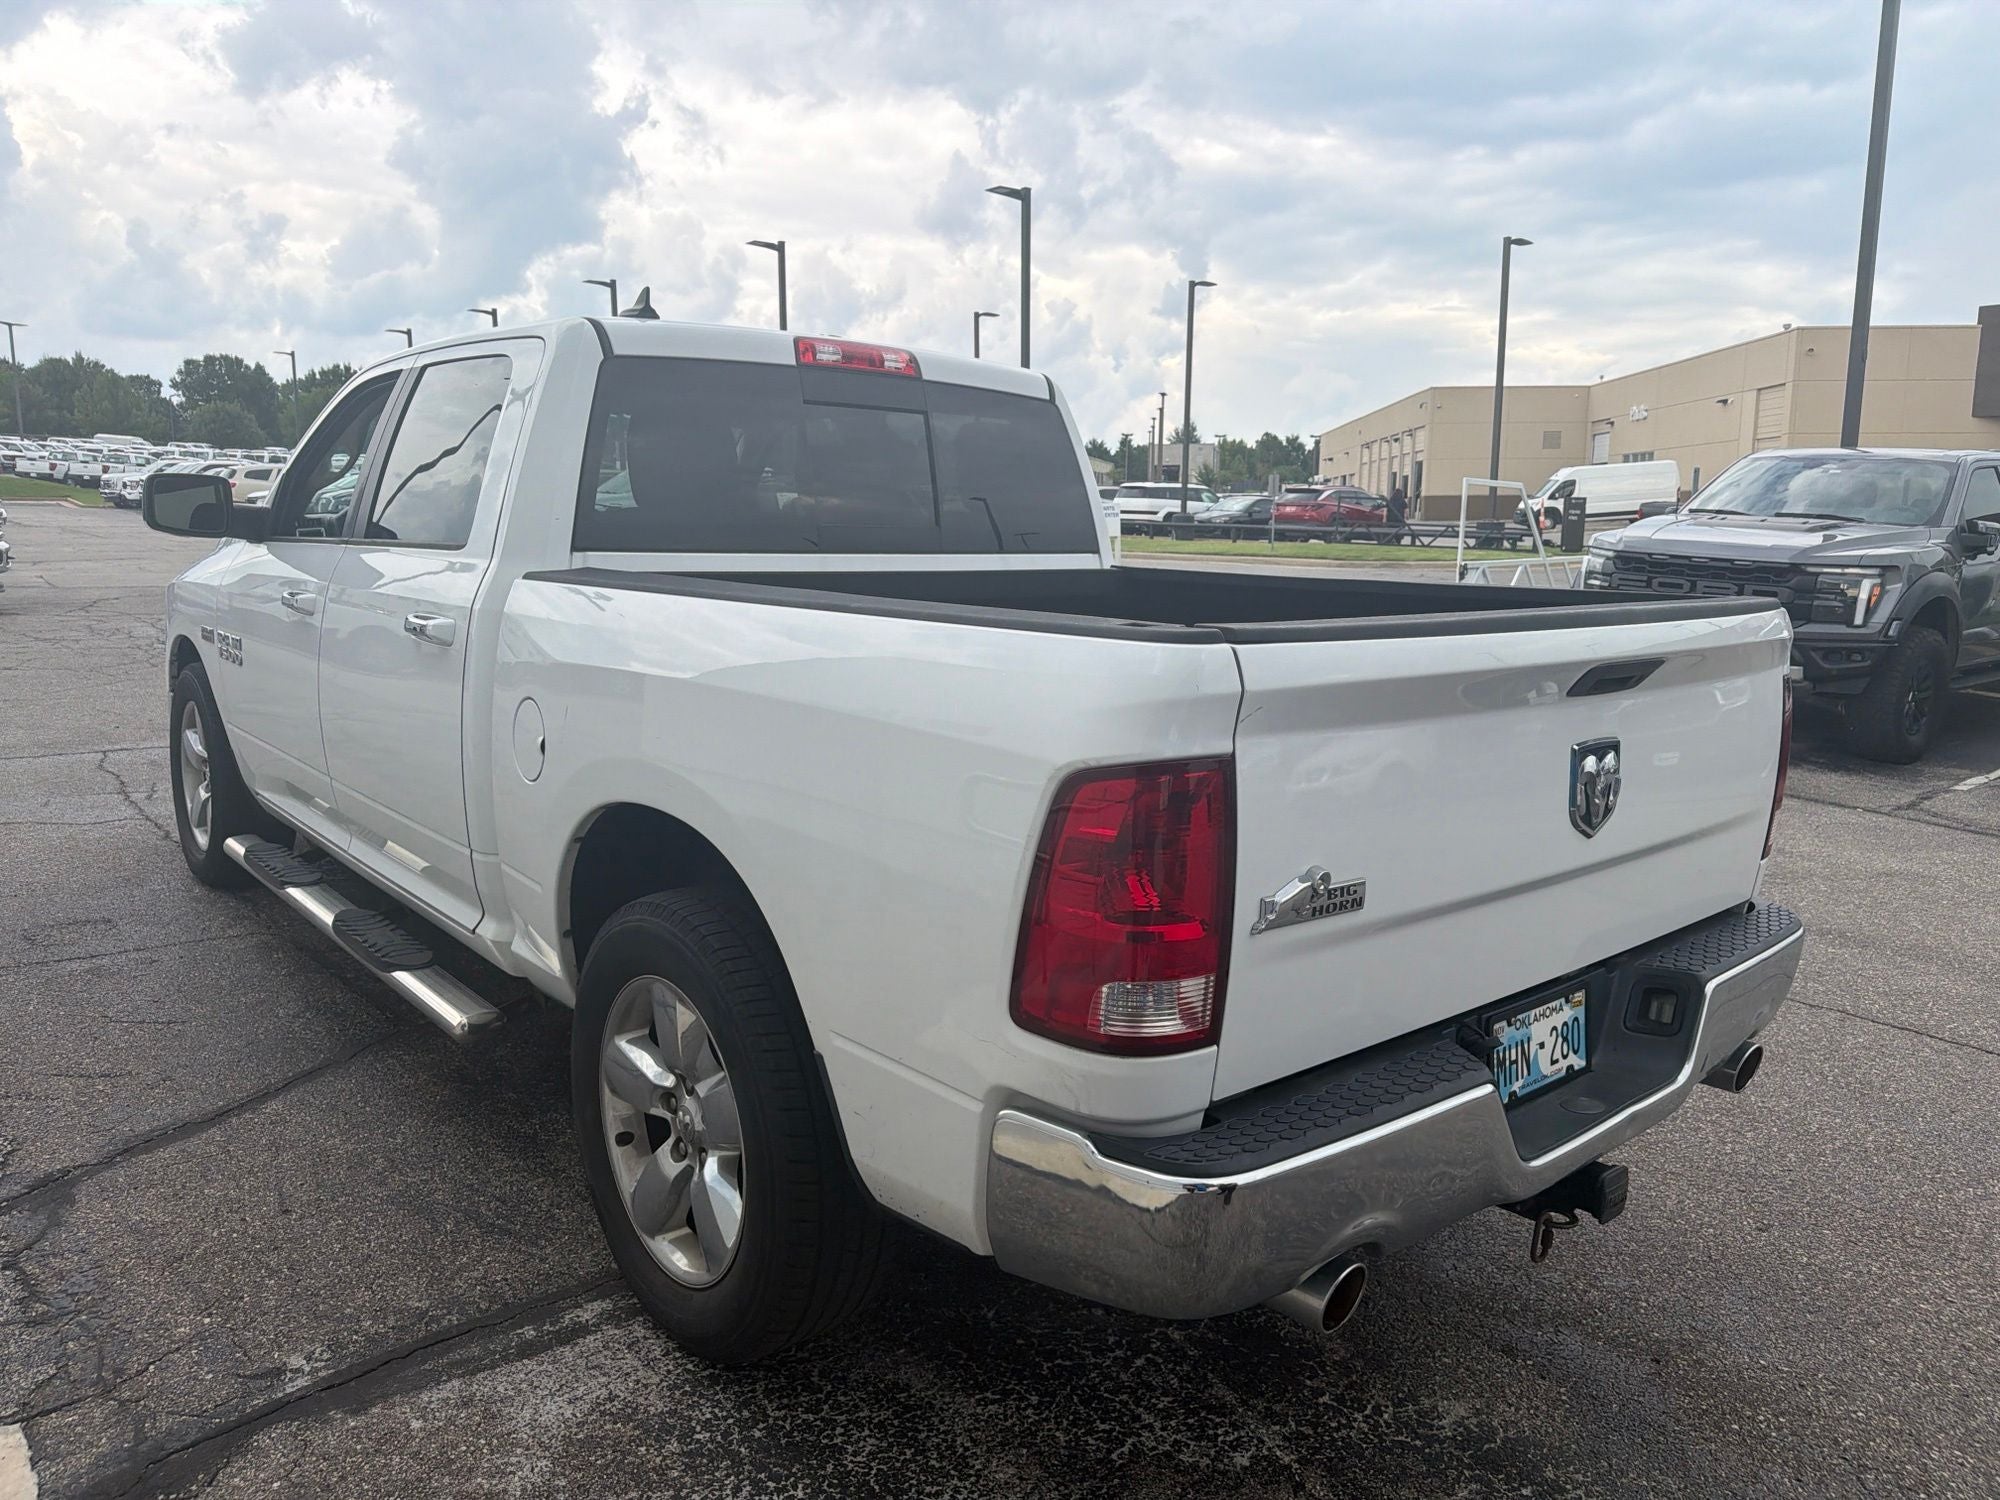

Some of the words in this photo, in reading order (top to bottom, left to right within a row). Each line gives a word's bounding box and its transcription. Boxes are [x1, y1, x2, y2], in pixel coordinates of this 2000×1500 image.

[1611, 573, 1795, 604] FORD
[1311, 896, 1363, 917] HORN
[1327, 884, 1358, 901] BIG
[1514, 1001, 1565, 1031] OKLAHOMA
[1550, 1016, 1581, 1067] 280
